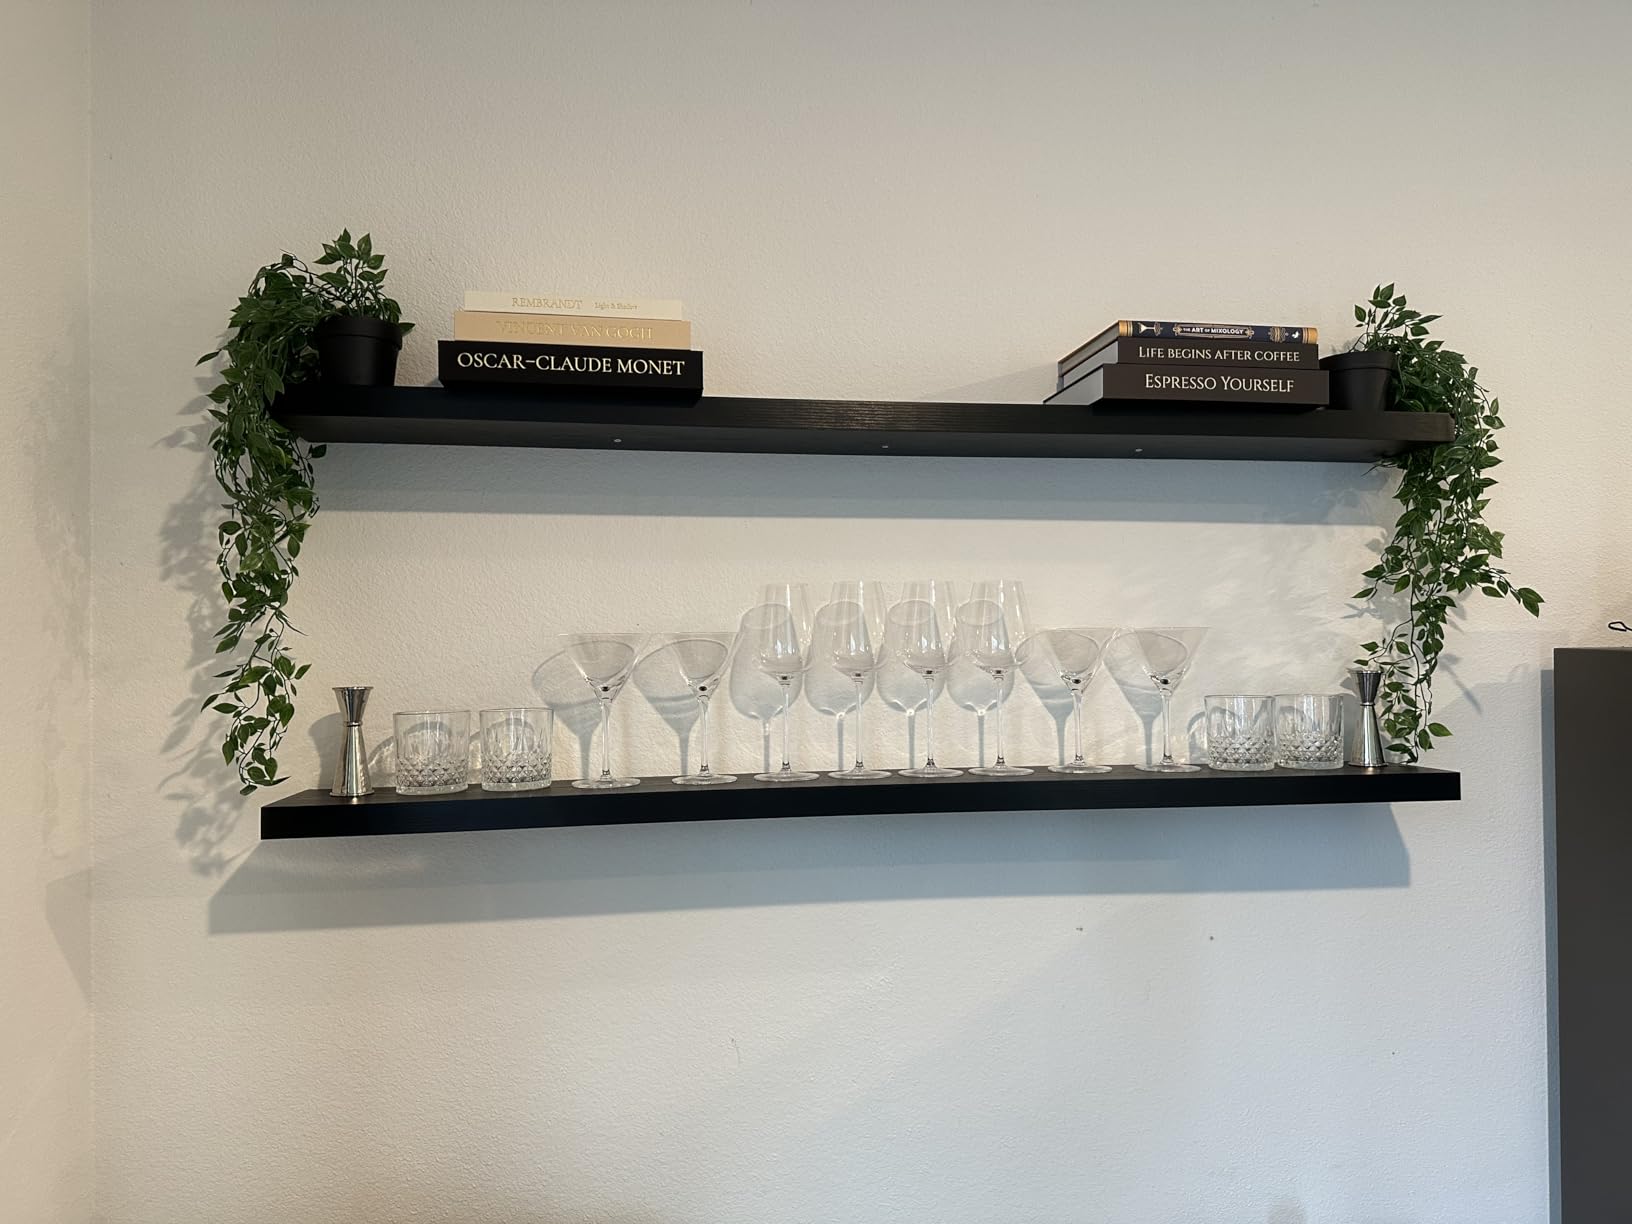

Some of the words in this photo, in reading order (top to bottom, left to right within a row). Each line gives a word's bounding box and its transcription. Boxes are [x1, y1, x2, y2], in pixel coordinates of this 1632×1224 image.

[512, 297, 583, 310] REMBRANDT
[496, 320, 565, 336] VINCENT
[569, 324, 602, 338] VAN
[606, 326, 653, 340] GOGH
[1138, 345, 1164, 359] LIFE
[1167, 348, 1212, 360] BEGINS
[1215, 349, 1252, 361] AFTER
[1254, 350, 1300, 362] COFFEE
[617, 358, 686, 376] MONET
[1145, 373, 1217, 390] ESPRESSO
[1220, 376, 1295, 393] YOURSELF
